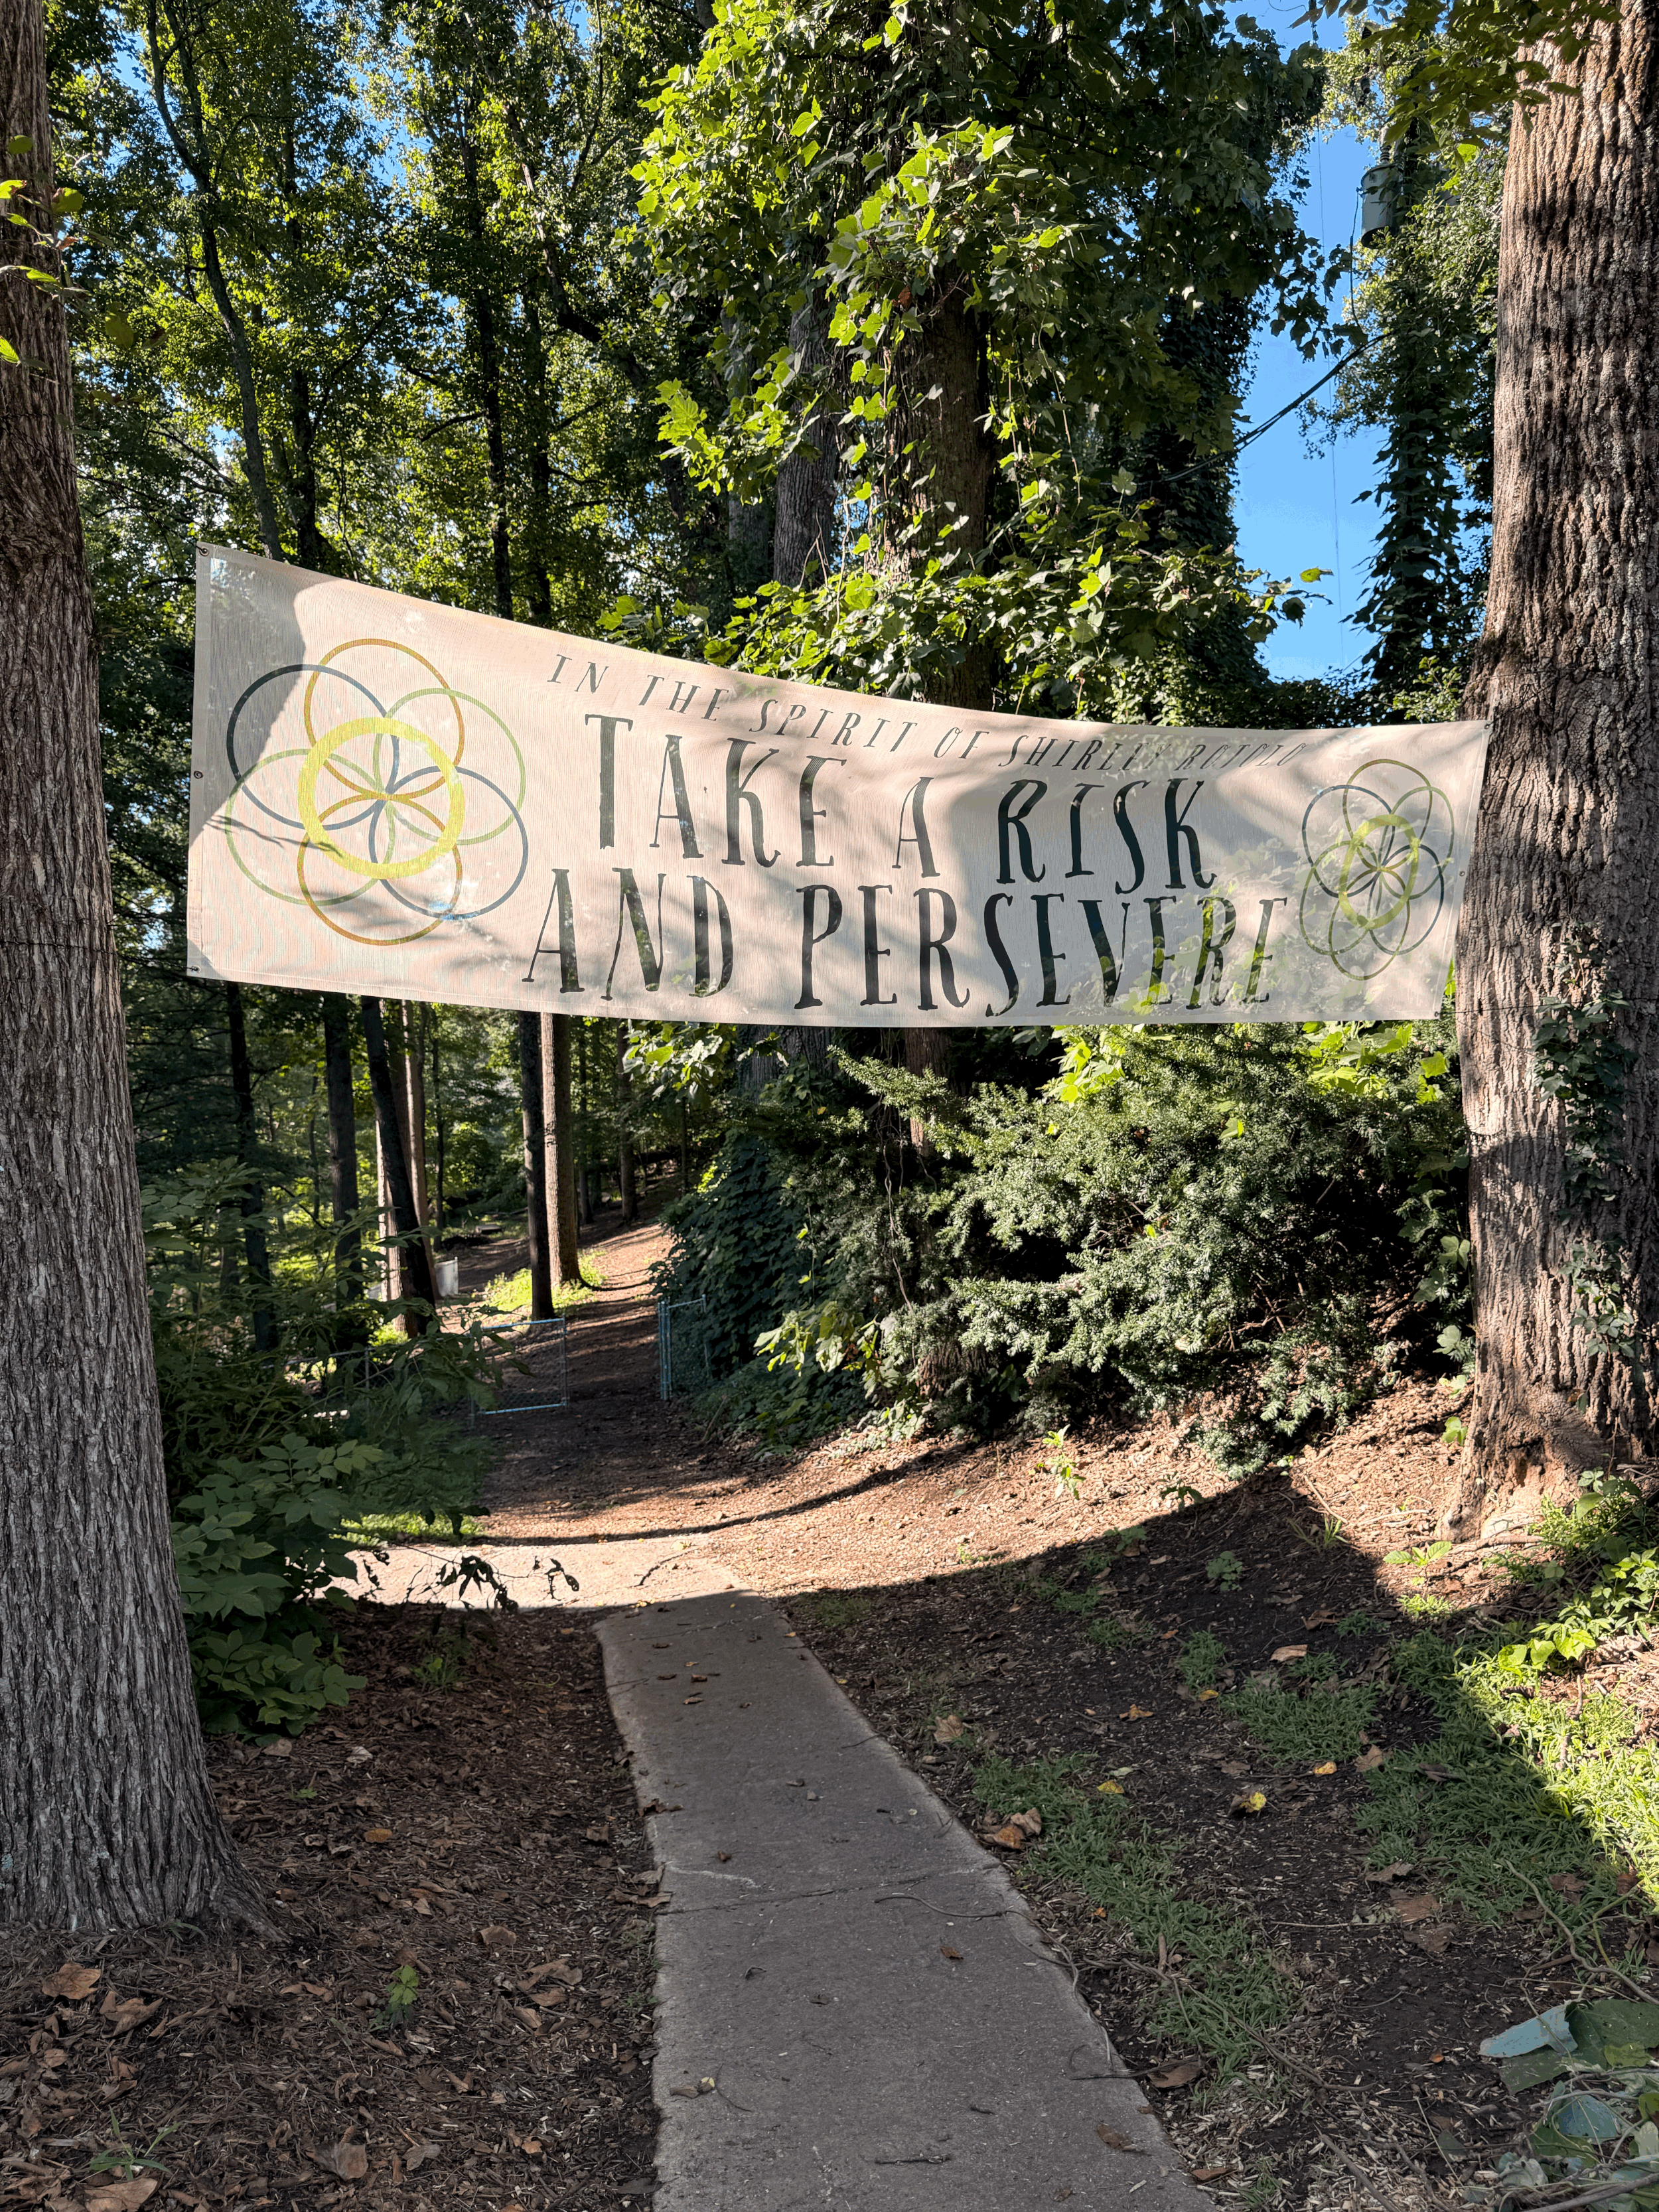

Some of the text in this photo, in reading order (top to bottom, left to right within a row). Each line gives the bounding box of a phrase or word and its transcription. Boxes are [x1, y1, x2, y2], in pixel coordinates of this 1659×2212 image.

[546, 654, 1309, 771] IN THE SPIRIT OF SHIRLEY ROTOLO
[585, 713, 1218, 895] TAKE A RISK
[522, 867, 1289, 1018] AND PERSEVERE
